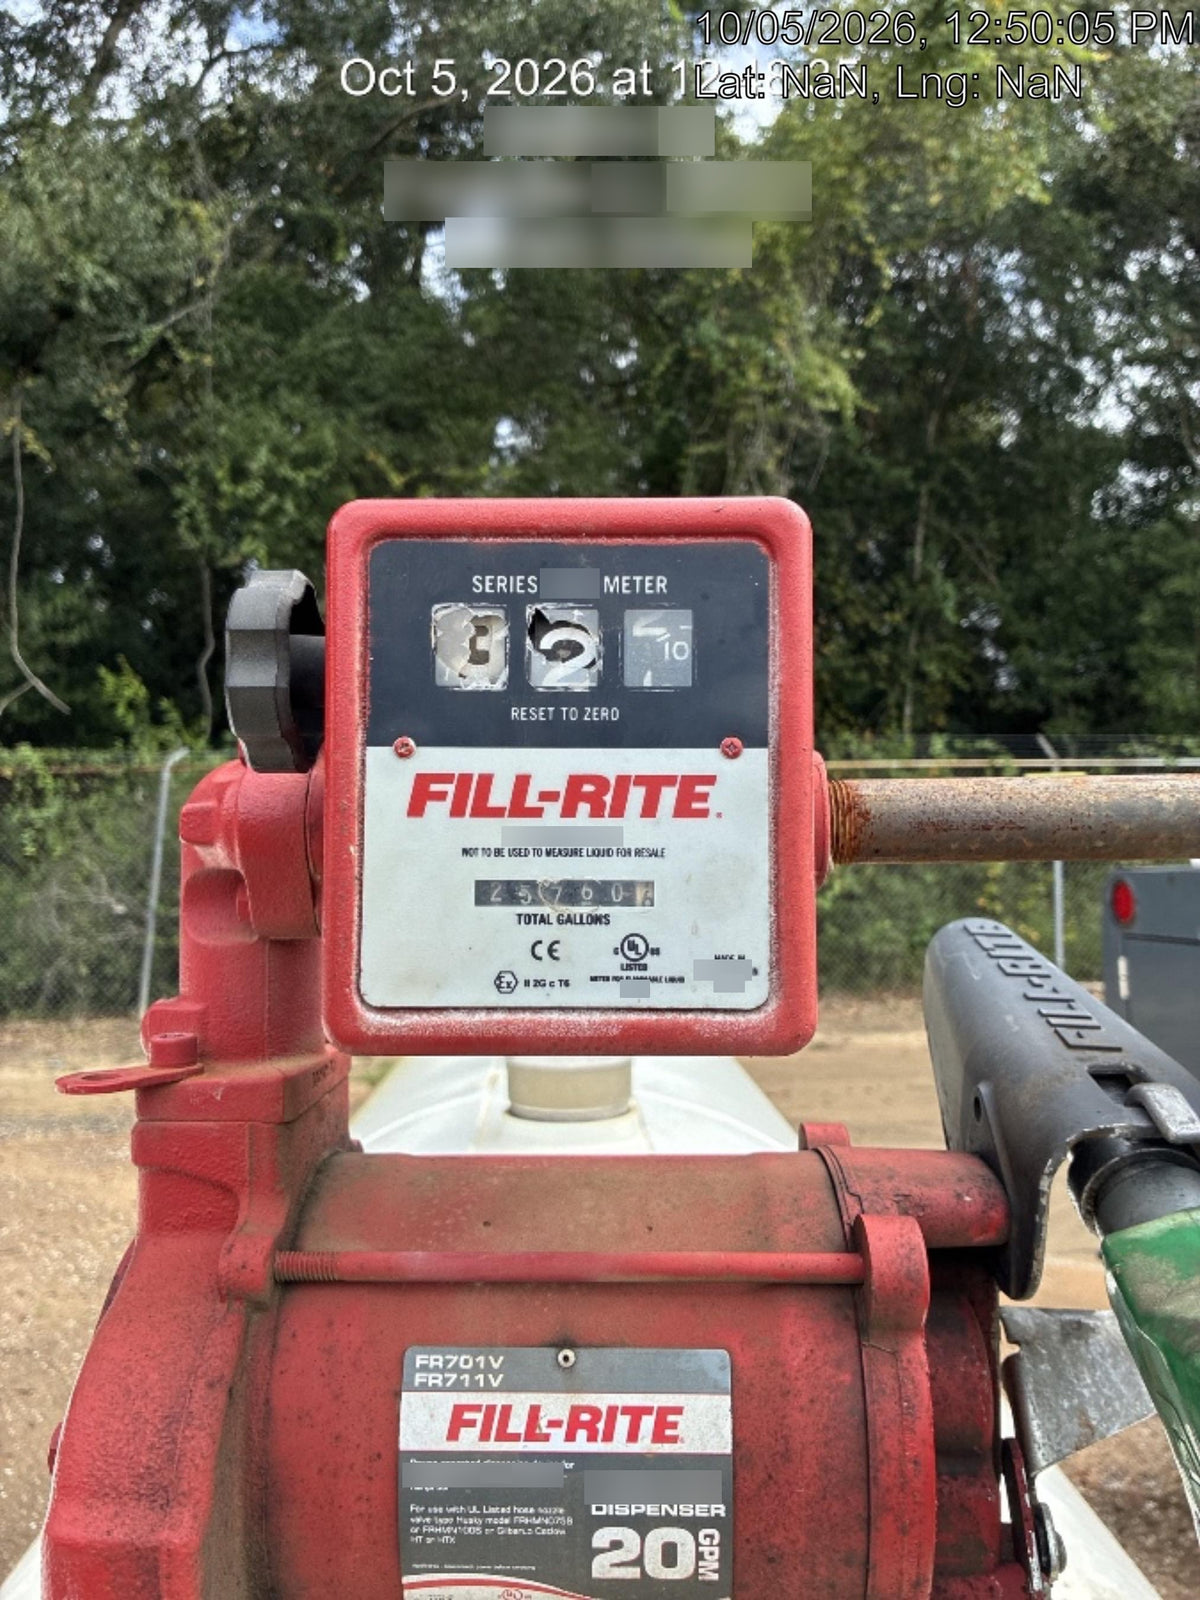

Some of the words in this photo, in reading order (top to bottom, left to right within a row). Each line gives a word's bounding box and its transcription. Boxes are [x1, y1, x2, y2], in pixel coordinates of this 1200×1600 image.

[472, 576, 538, 593] SERIES
[604, 576, 667, 594] METER
[511, 707, 554, 721] RESET
[561, 707, 578, 721] TO
[584, 707, 620, 721] ZERO
[407, 773, 717, 819] FILL-RITE
[462, 847, 478, 858] NOT
[494, 847, 505, 858] BE
[508, 847, 530, 858] USED
[532, 847, 542, 858] TO
[545, 847, 584, 858] MEASURE
[586, 847, 614, 858] LIQUID
[616, 847, 632, 858] FOR
[634, 847, 666, 858] RESALE
[516, 913, 553, 925] TOTAL
[557, 913, 611, 925] GALLONS
[620, 963, 648, 971] LISTED
[415, 1355, 504, 1369] FR701V
[414, 1374, 504, 1388] FR711V
[446, 1404, 685, 1444] FILL-RITE
[591, 1504, 726, 1517] DISPENSER
[591, 1527, 696, 1580] 20
[698, 1528, 719, 1581] GPM
